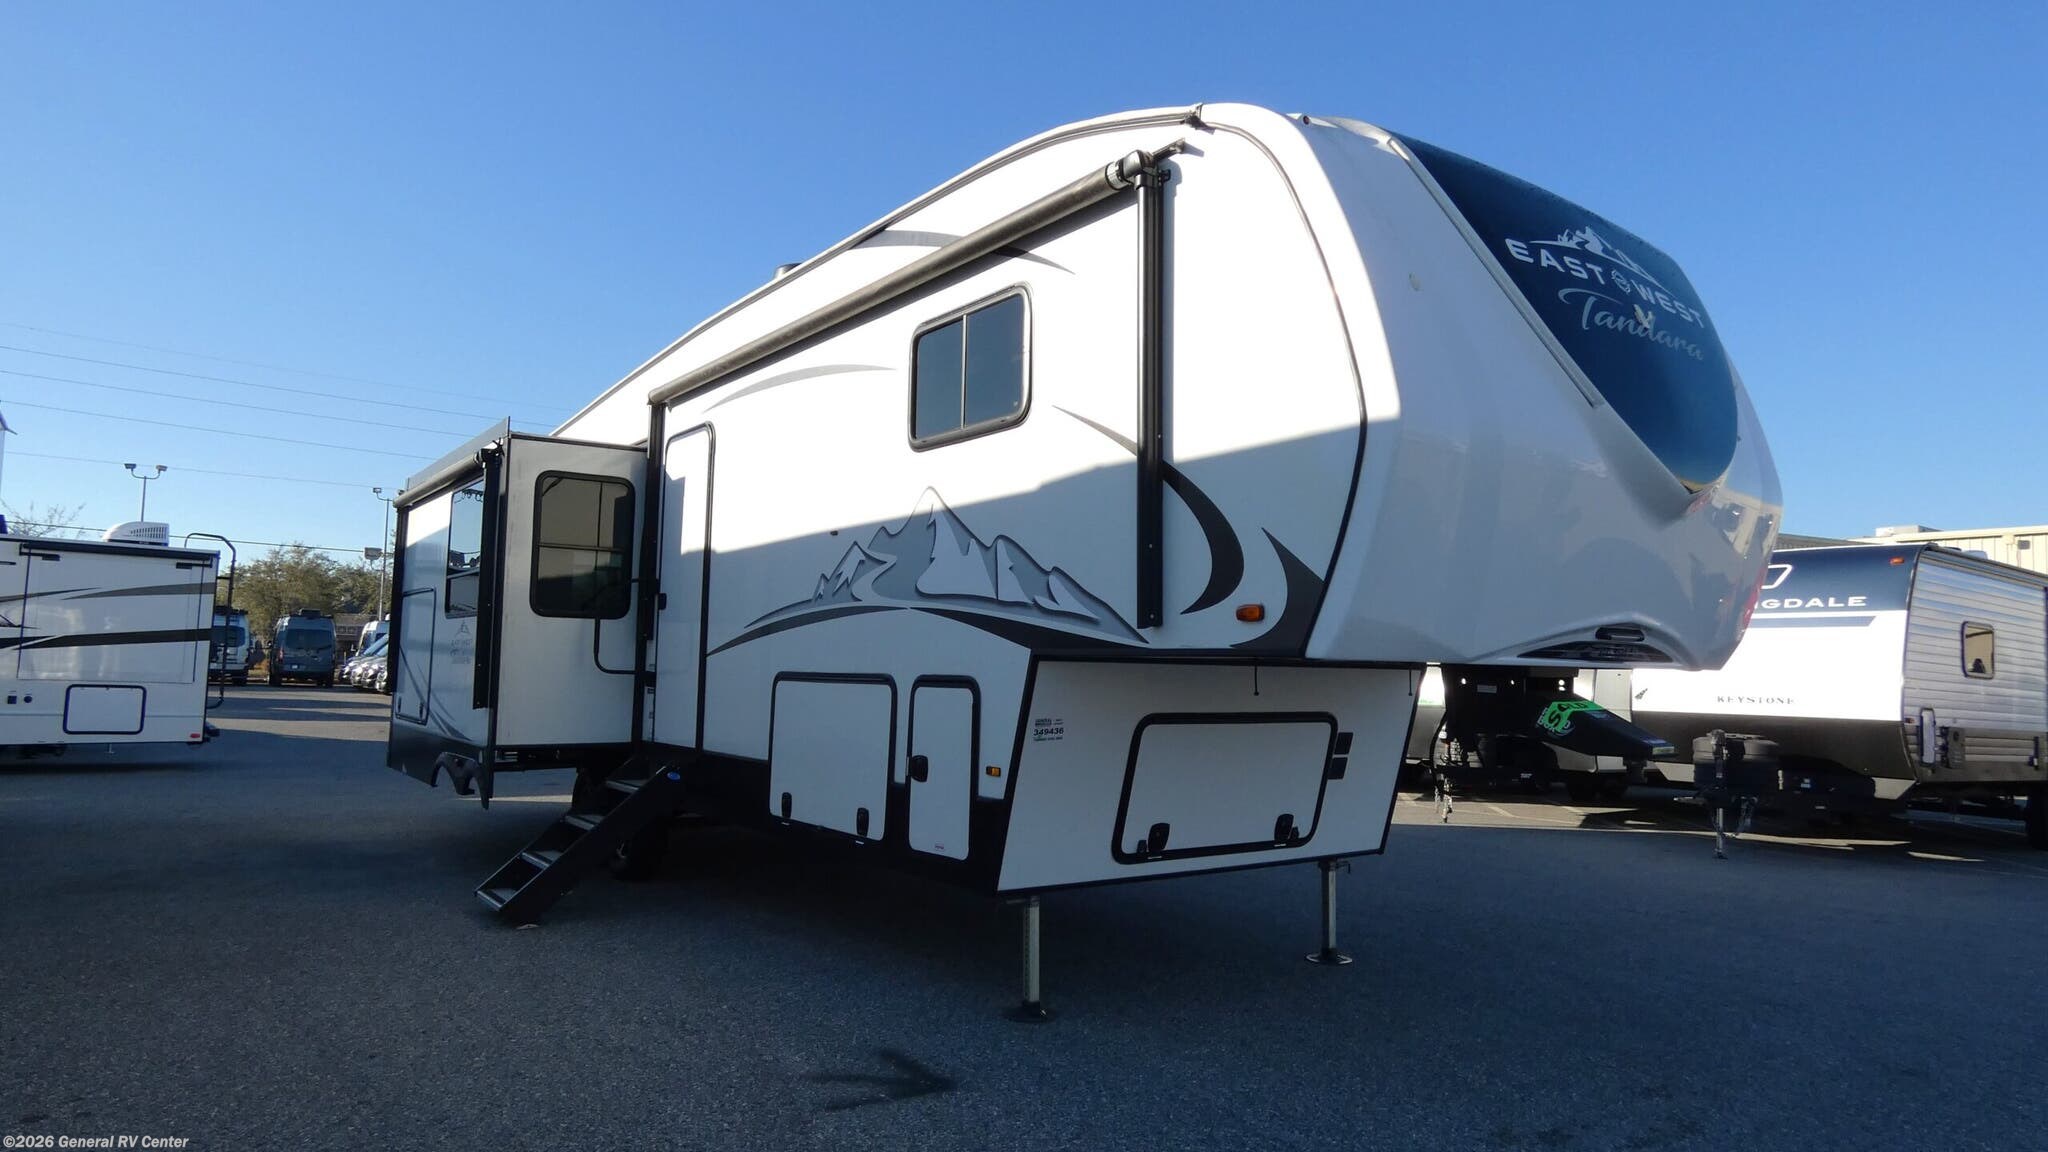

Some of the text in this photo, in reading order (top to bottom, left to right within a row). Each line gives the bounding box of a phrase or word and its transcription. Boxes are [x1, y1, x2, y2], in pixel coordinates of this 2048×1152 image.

[1505, 238, 1704, 329] EAST WEST
[1557, 288, 1705, 361] Tandara
[1717, 695, 1795, 705] KEYSTONE
